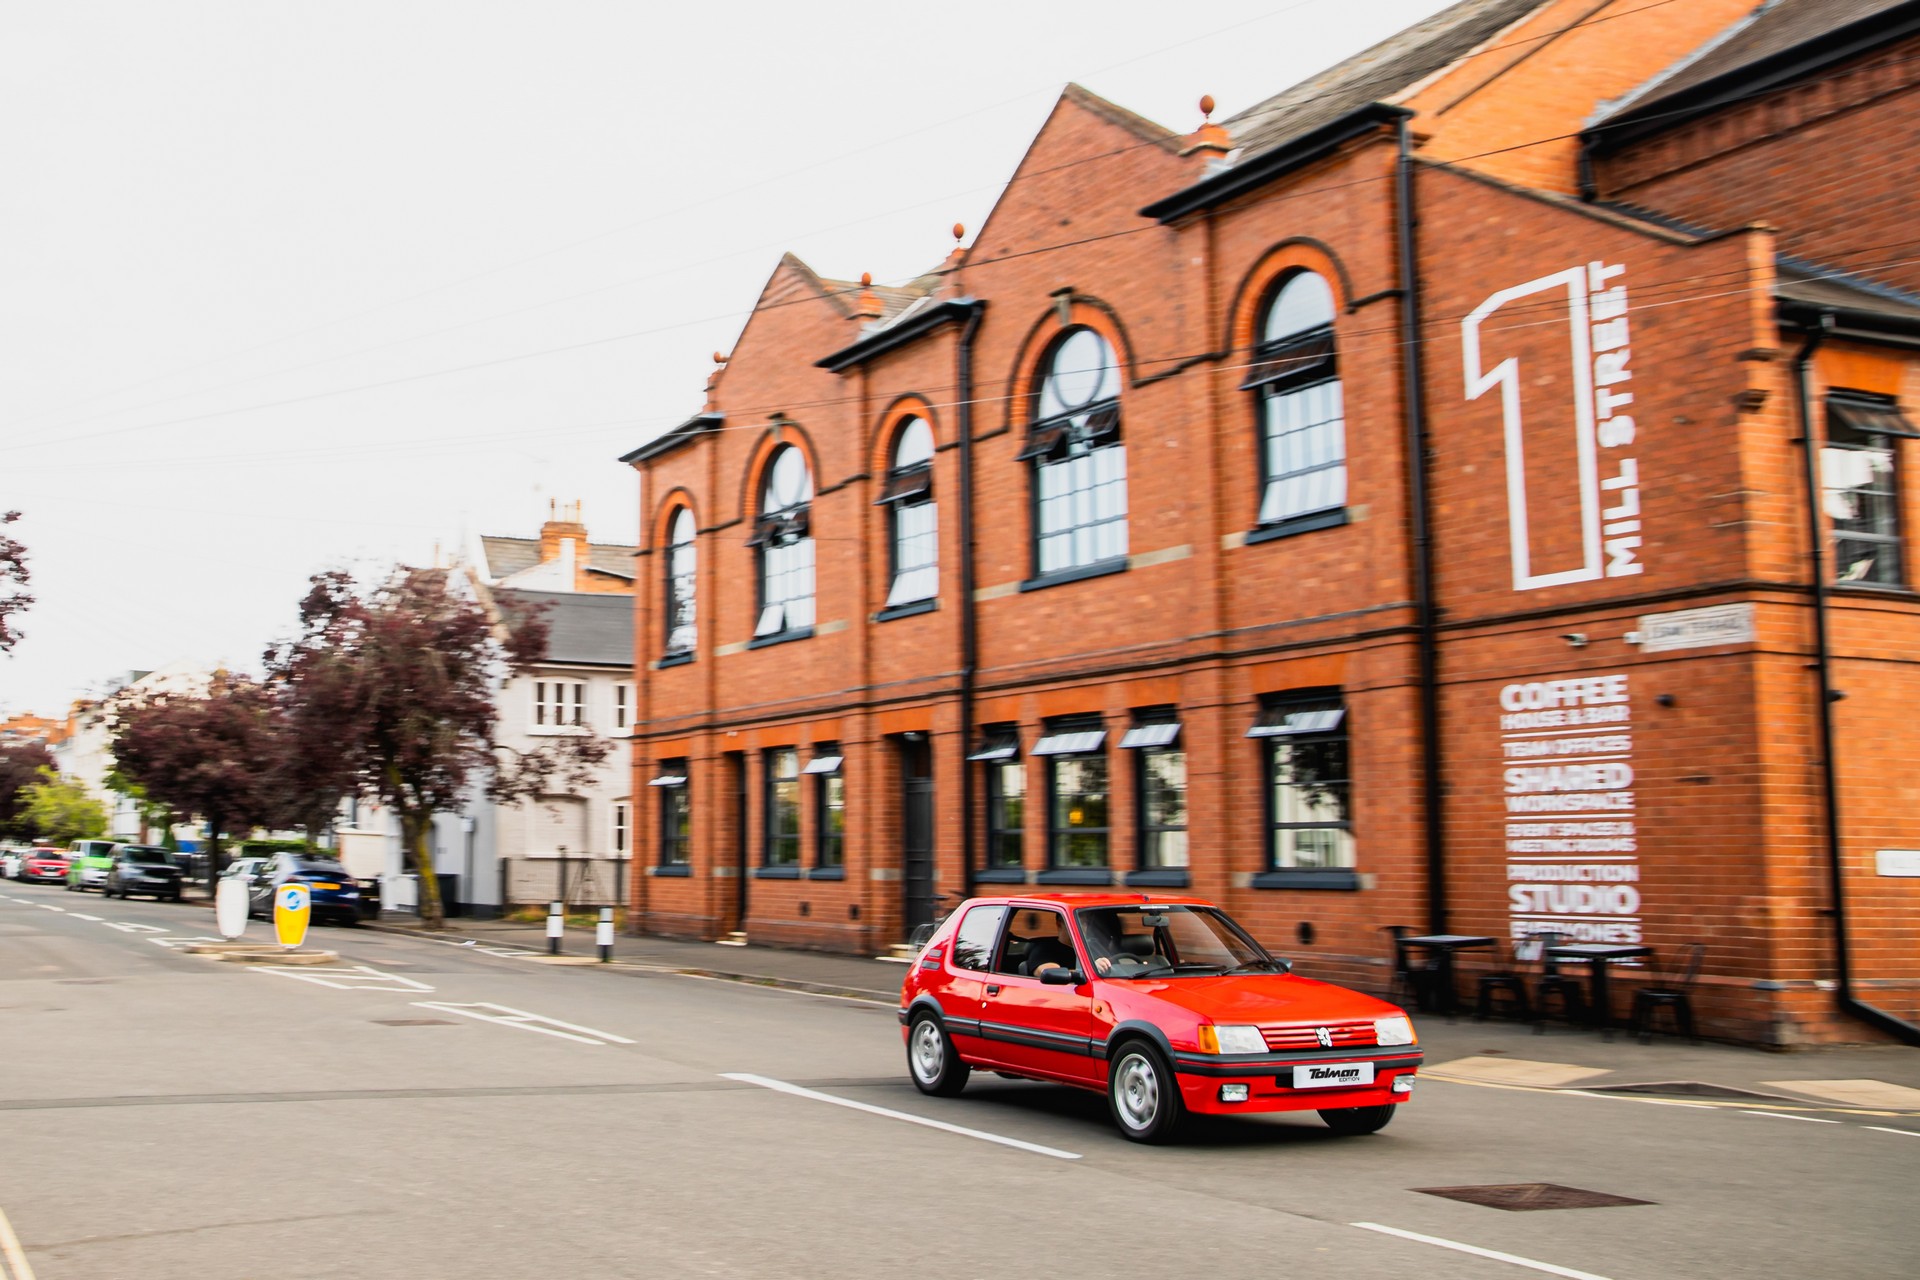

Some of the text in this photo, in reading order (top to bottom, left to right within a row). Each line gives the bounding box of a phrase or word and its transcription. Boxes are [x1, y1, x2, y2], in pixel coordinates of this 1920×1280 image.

[1462, 266, 1603, 591] 1
[1588, 260, 1644, 578] MILL STREET
[1500, 674, 1630, 712] COFFEE
[1504, 762, 1634, 794] SHARED
[1505, 792, 1635, 812] WORKSPACE
[1507, 864, 1639, 882] PRODUCTION
[1509, 884, 1641, 914] STUDIO
[1309, 1068, 1360, 1079] Tolman
